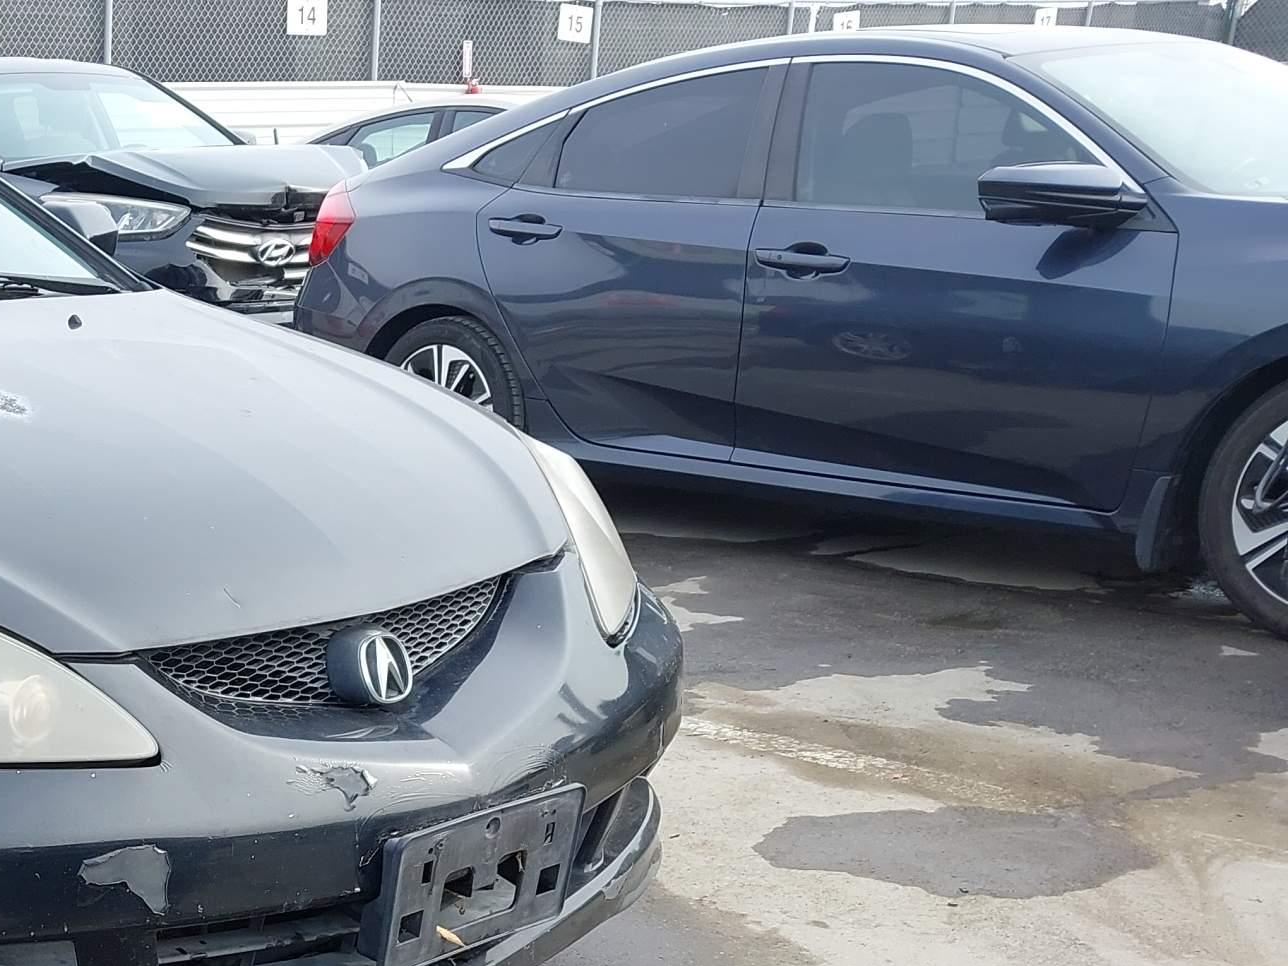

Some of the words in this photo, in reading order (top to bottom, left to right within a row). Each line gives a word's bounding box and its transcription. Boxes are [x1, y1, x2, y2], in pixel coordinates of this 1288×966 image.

[298, 5, 317, 25] 14
[568, 15, 584, 33] 15
[1040, 15, 1052, 26] 17
